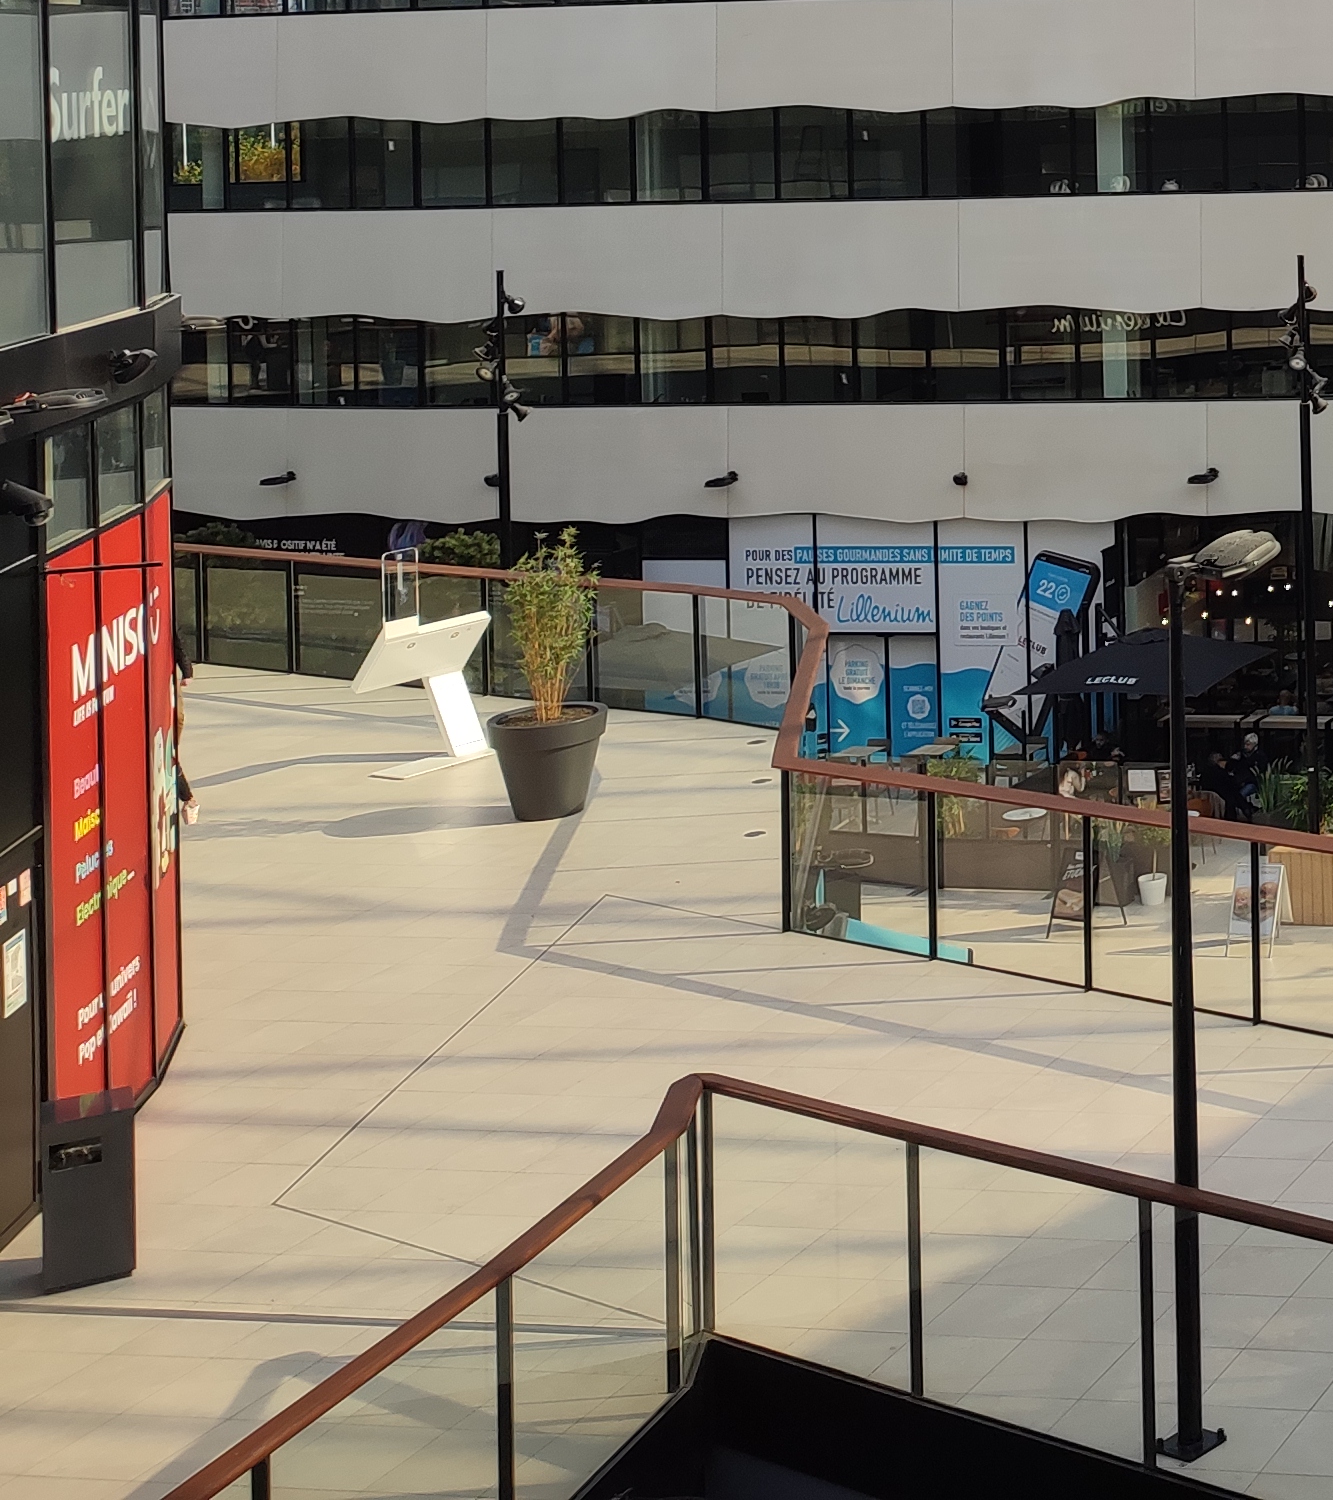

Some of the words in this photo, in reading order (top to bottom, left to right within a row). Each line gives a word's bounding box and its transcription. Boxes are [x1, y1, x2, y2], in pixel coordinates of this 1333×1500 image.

[50, 66, 129, 143] Surfer
[745, 550, 772, 561] POUR
[775, 550, 793, 561] DES
[837, 549, 900, 561] GOURMANDES
[902, 549, 928, 561] SANS
[966, 549, 978, 561] DE
[981, 549, 1012, 561] TEMPS
[746, 567, 800, 585] PENSEZ
[806, 567, 826, 585] AU
[831, 567, 922, 585] PROGRAMME
[1036, 579, 1054, 598] 22
[837, 594, 934, 624] Lillenium
[959, 601, 989, 610] GAGNEZ
[960, 612, 974, 621] DES
[976, 612, 1003, 622] POINTS
